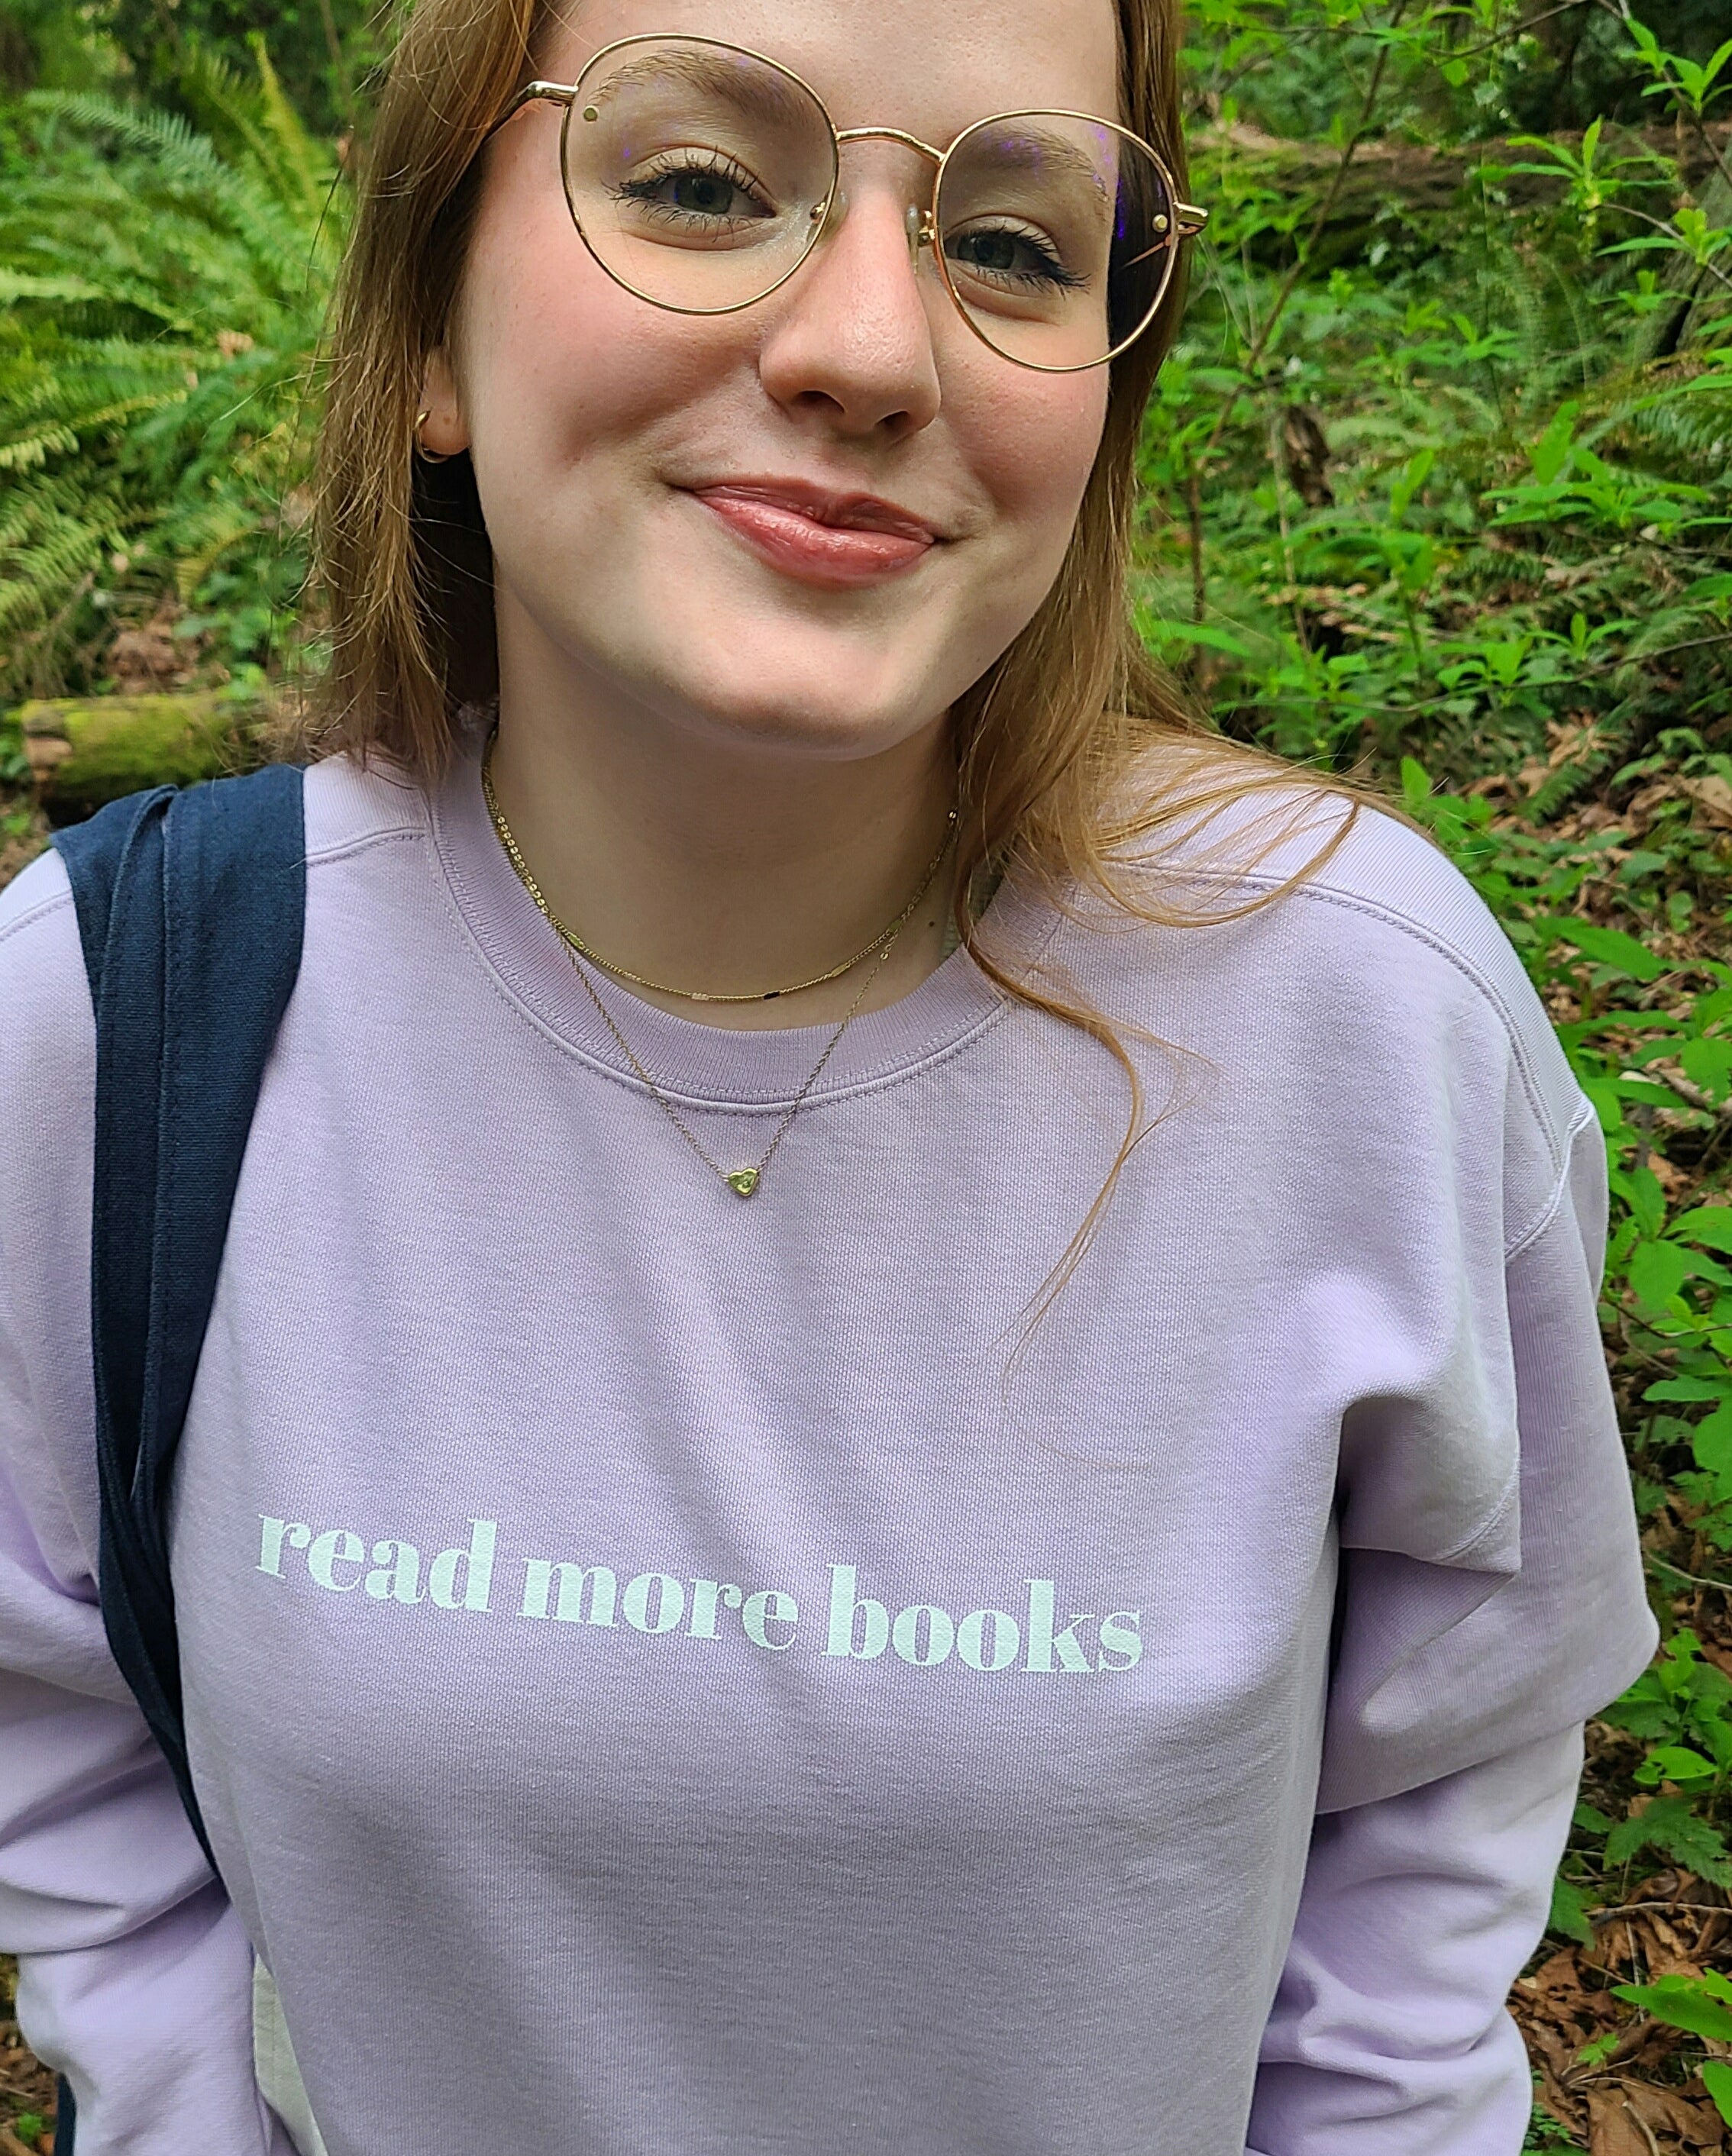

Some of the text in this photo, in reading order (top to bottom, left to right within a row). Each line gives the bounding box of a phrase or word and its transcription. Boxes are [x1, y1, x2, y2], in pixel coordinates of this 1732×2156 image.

[256, 1513, 1145, 1675] read more books
